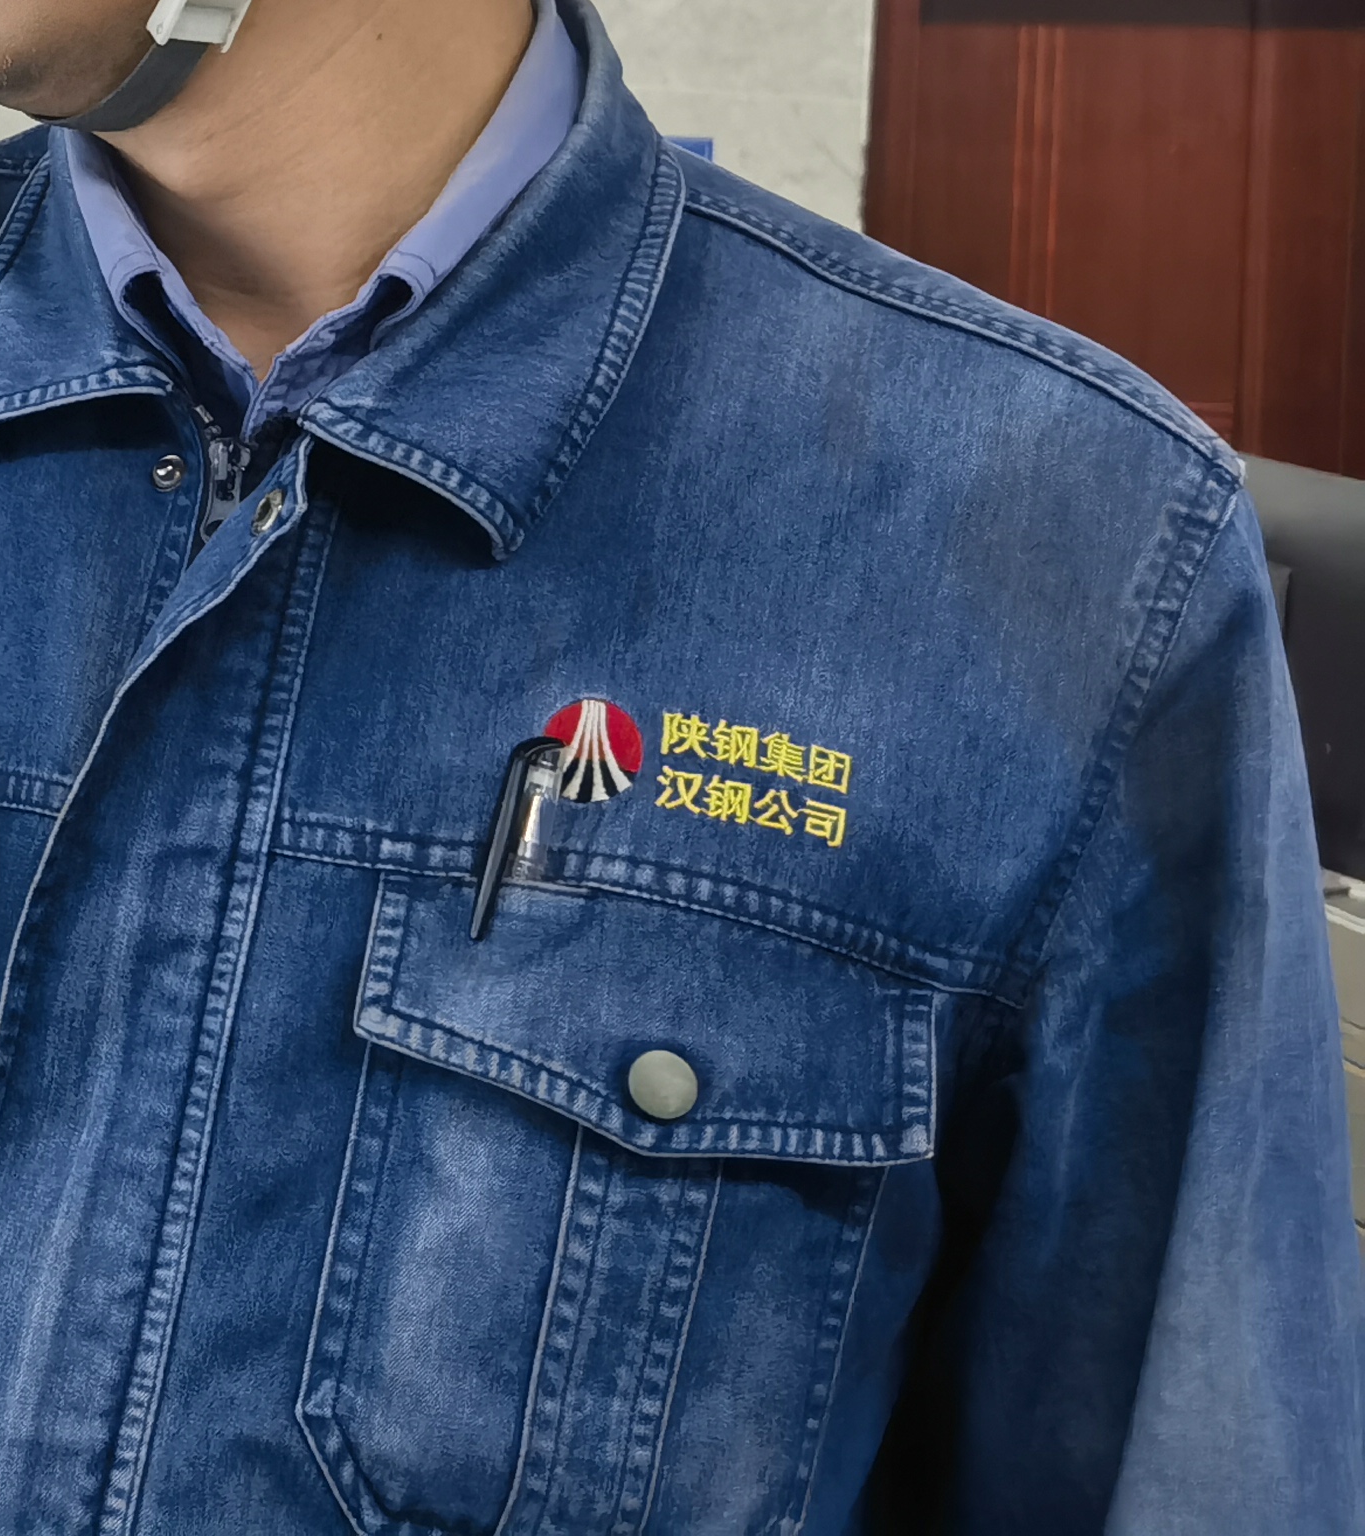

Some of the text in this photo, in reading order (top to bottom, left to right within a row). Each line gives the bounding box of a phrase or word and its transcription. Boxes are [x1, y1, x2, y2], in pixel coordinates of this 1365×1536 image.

[660, 712, 851, 794] 陕钢集团
[655, 765, 847, 848] 汉钢公司
